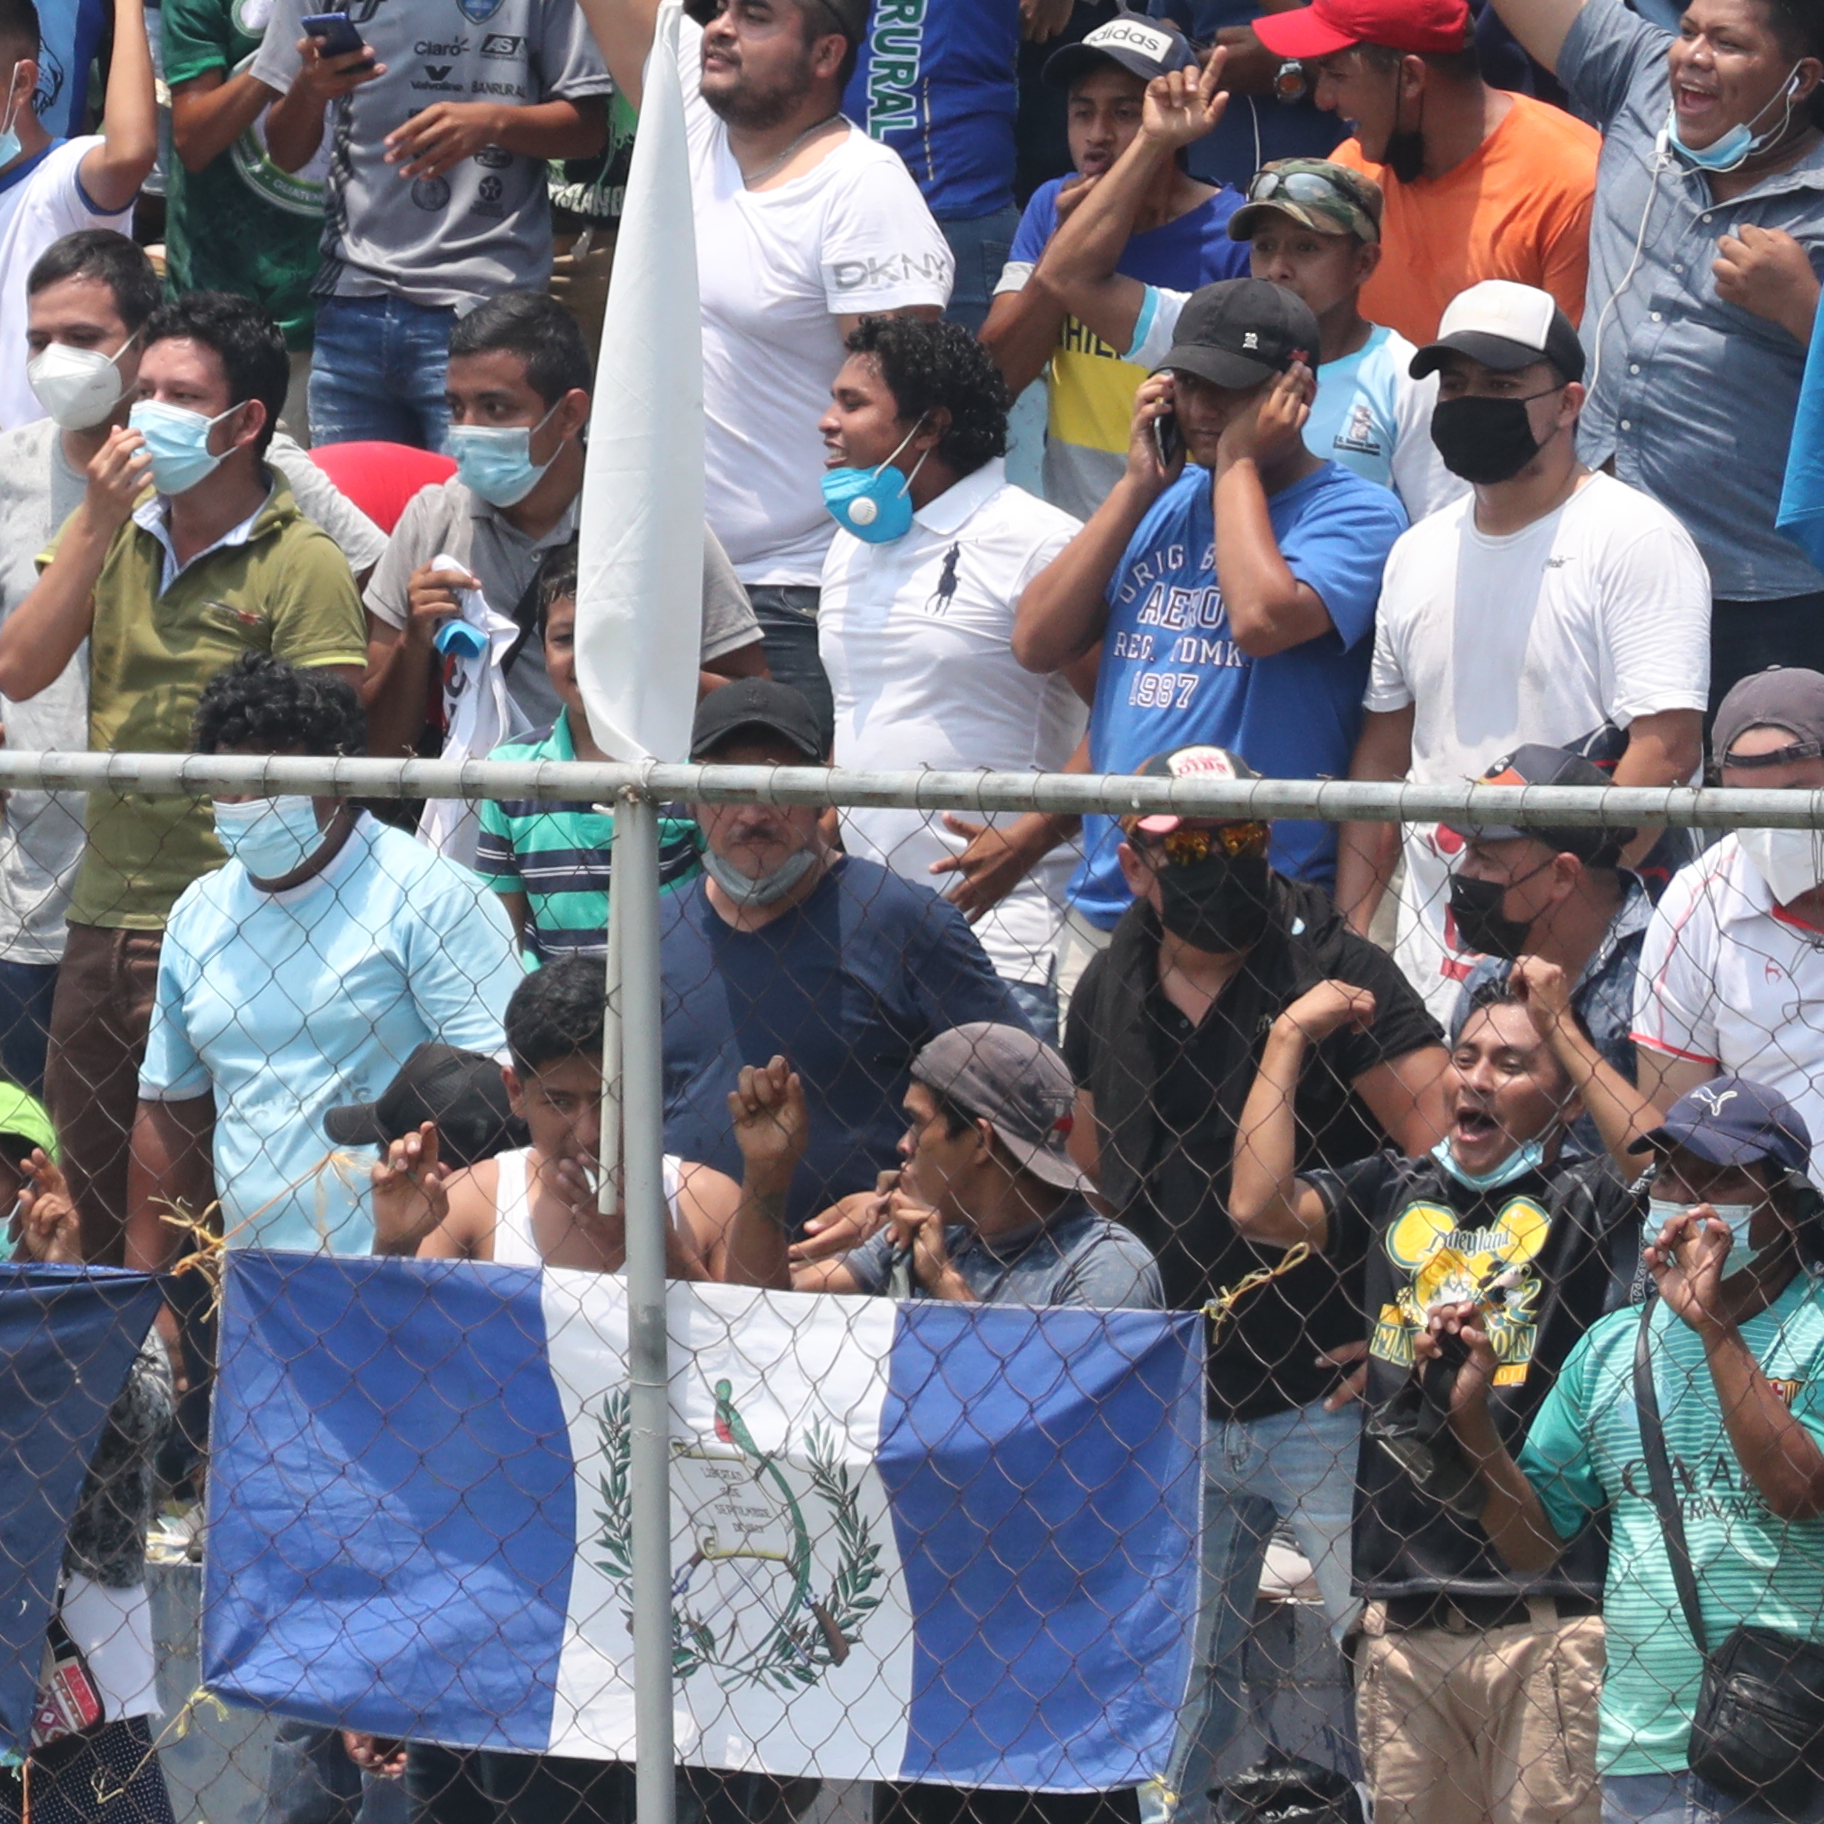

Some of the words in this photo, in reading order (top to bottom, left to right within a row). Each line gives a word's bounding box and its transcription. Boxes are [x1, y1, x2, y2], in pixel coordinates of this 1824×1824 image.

[413, 41, 462, 57] Claro
[411, 80, 464, 93] Valvoline
[471, 81, 527, 98] BANRURAL
[833, 253, 946, 290] DKNY
[1117, 542, 1185, 606] ORIG
[1127, 671, 1201, 710] 1987
